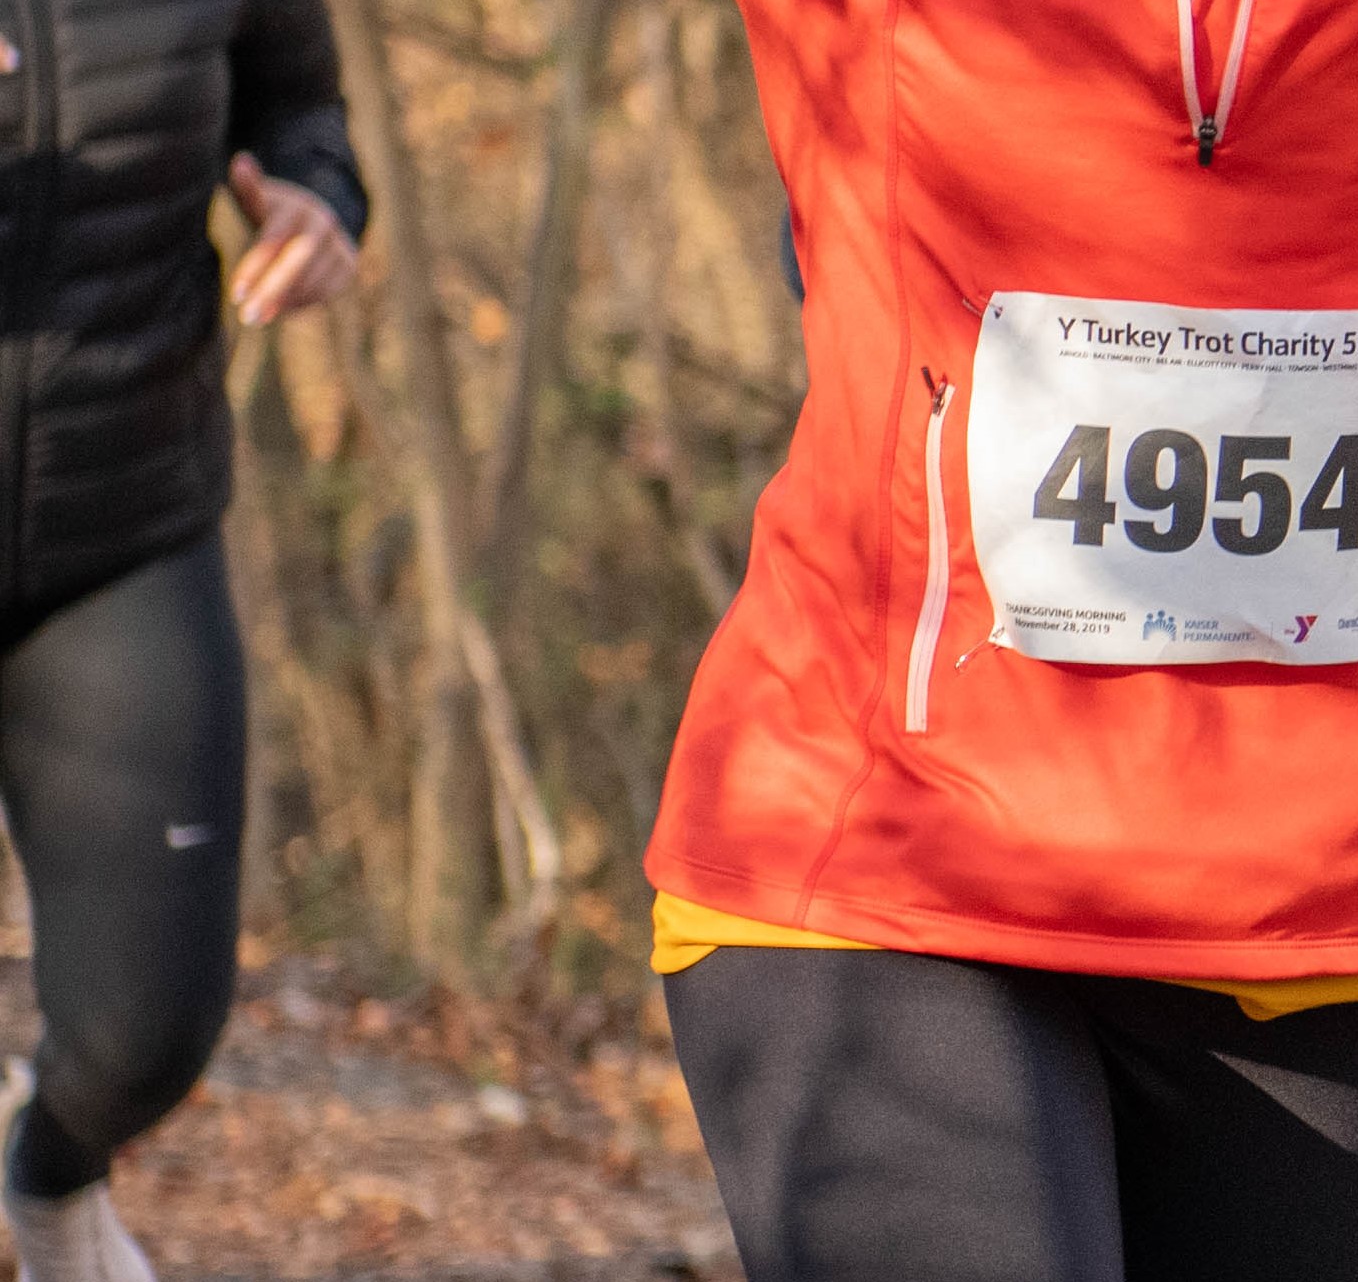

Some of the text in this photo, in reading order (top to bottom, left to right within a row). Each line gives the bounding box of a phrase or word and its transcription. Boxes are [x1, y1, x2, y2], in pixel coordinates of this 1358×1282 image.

[1058, 316, 1076, 341] Y
[1082, 319, 1172, 355] Turkey
[1178, 327, 1234, 354] Trot
[1241, 332, 1335, 362] Charity
[1093, 352, 1133, 363] BALTIMORE
[1135, 356, 1151, 364] CITY
[1005, 602, 1126, 622] THANKSGIVING MORNING
[1015, 618, 1110, 634] November 28, 2019
[1184, 619, 1219, 629] KAISER
